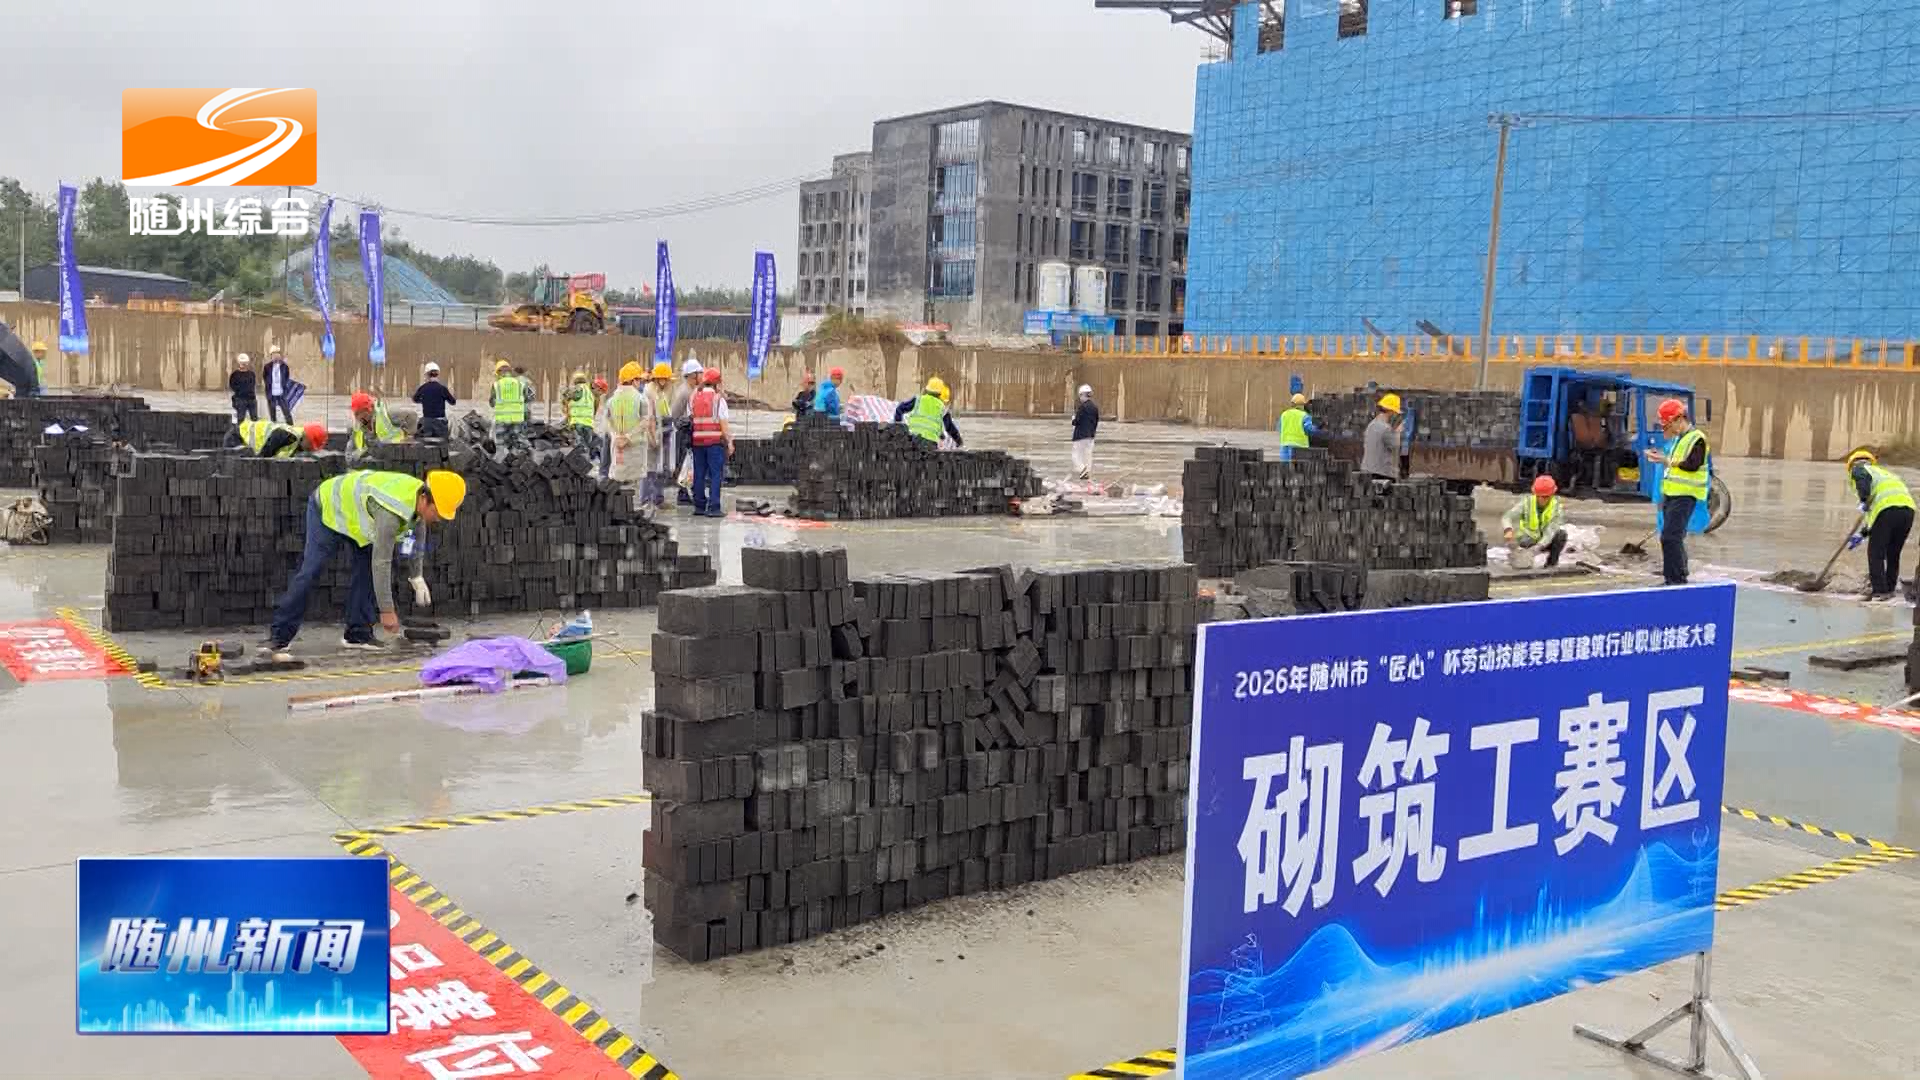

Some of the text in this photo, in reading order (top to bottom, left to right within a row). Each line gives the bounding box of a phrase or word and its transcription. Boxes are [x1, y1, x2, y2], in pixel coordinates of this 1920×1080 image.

[1237, 686, 1705, 918] 砌筑工赛区
